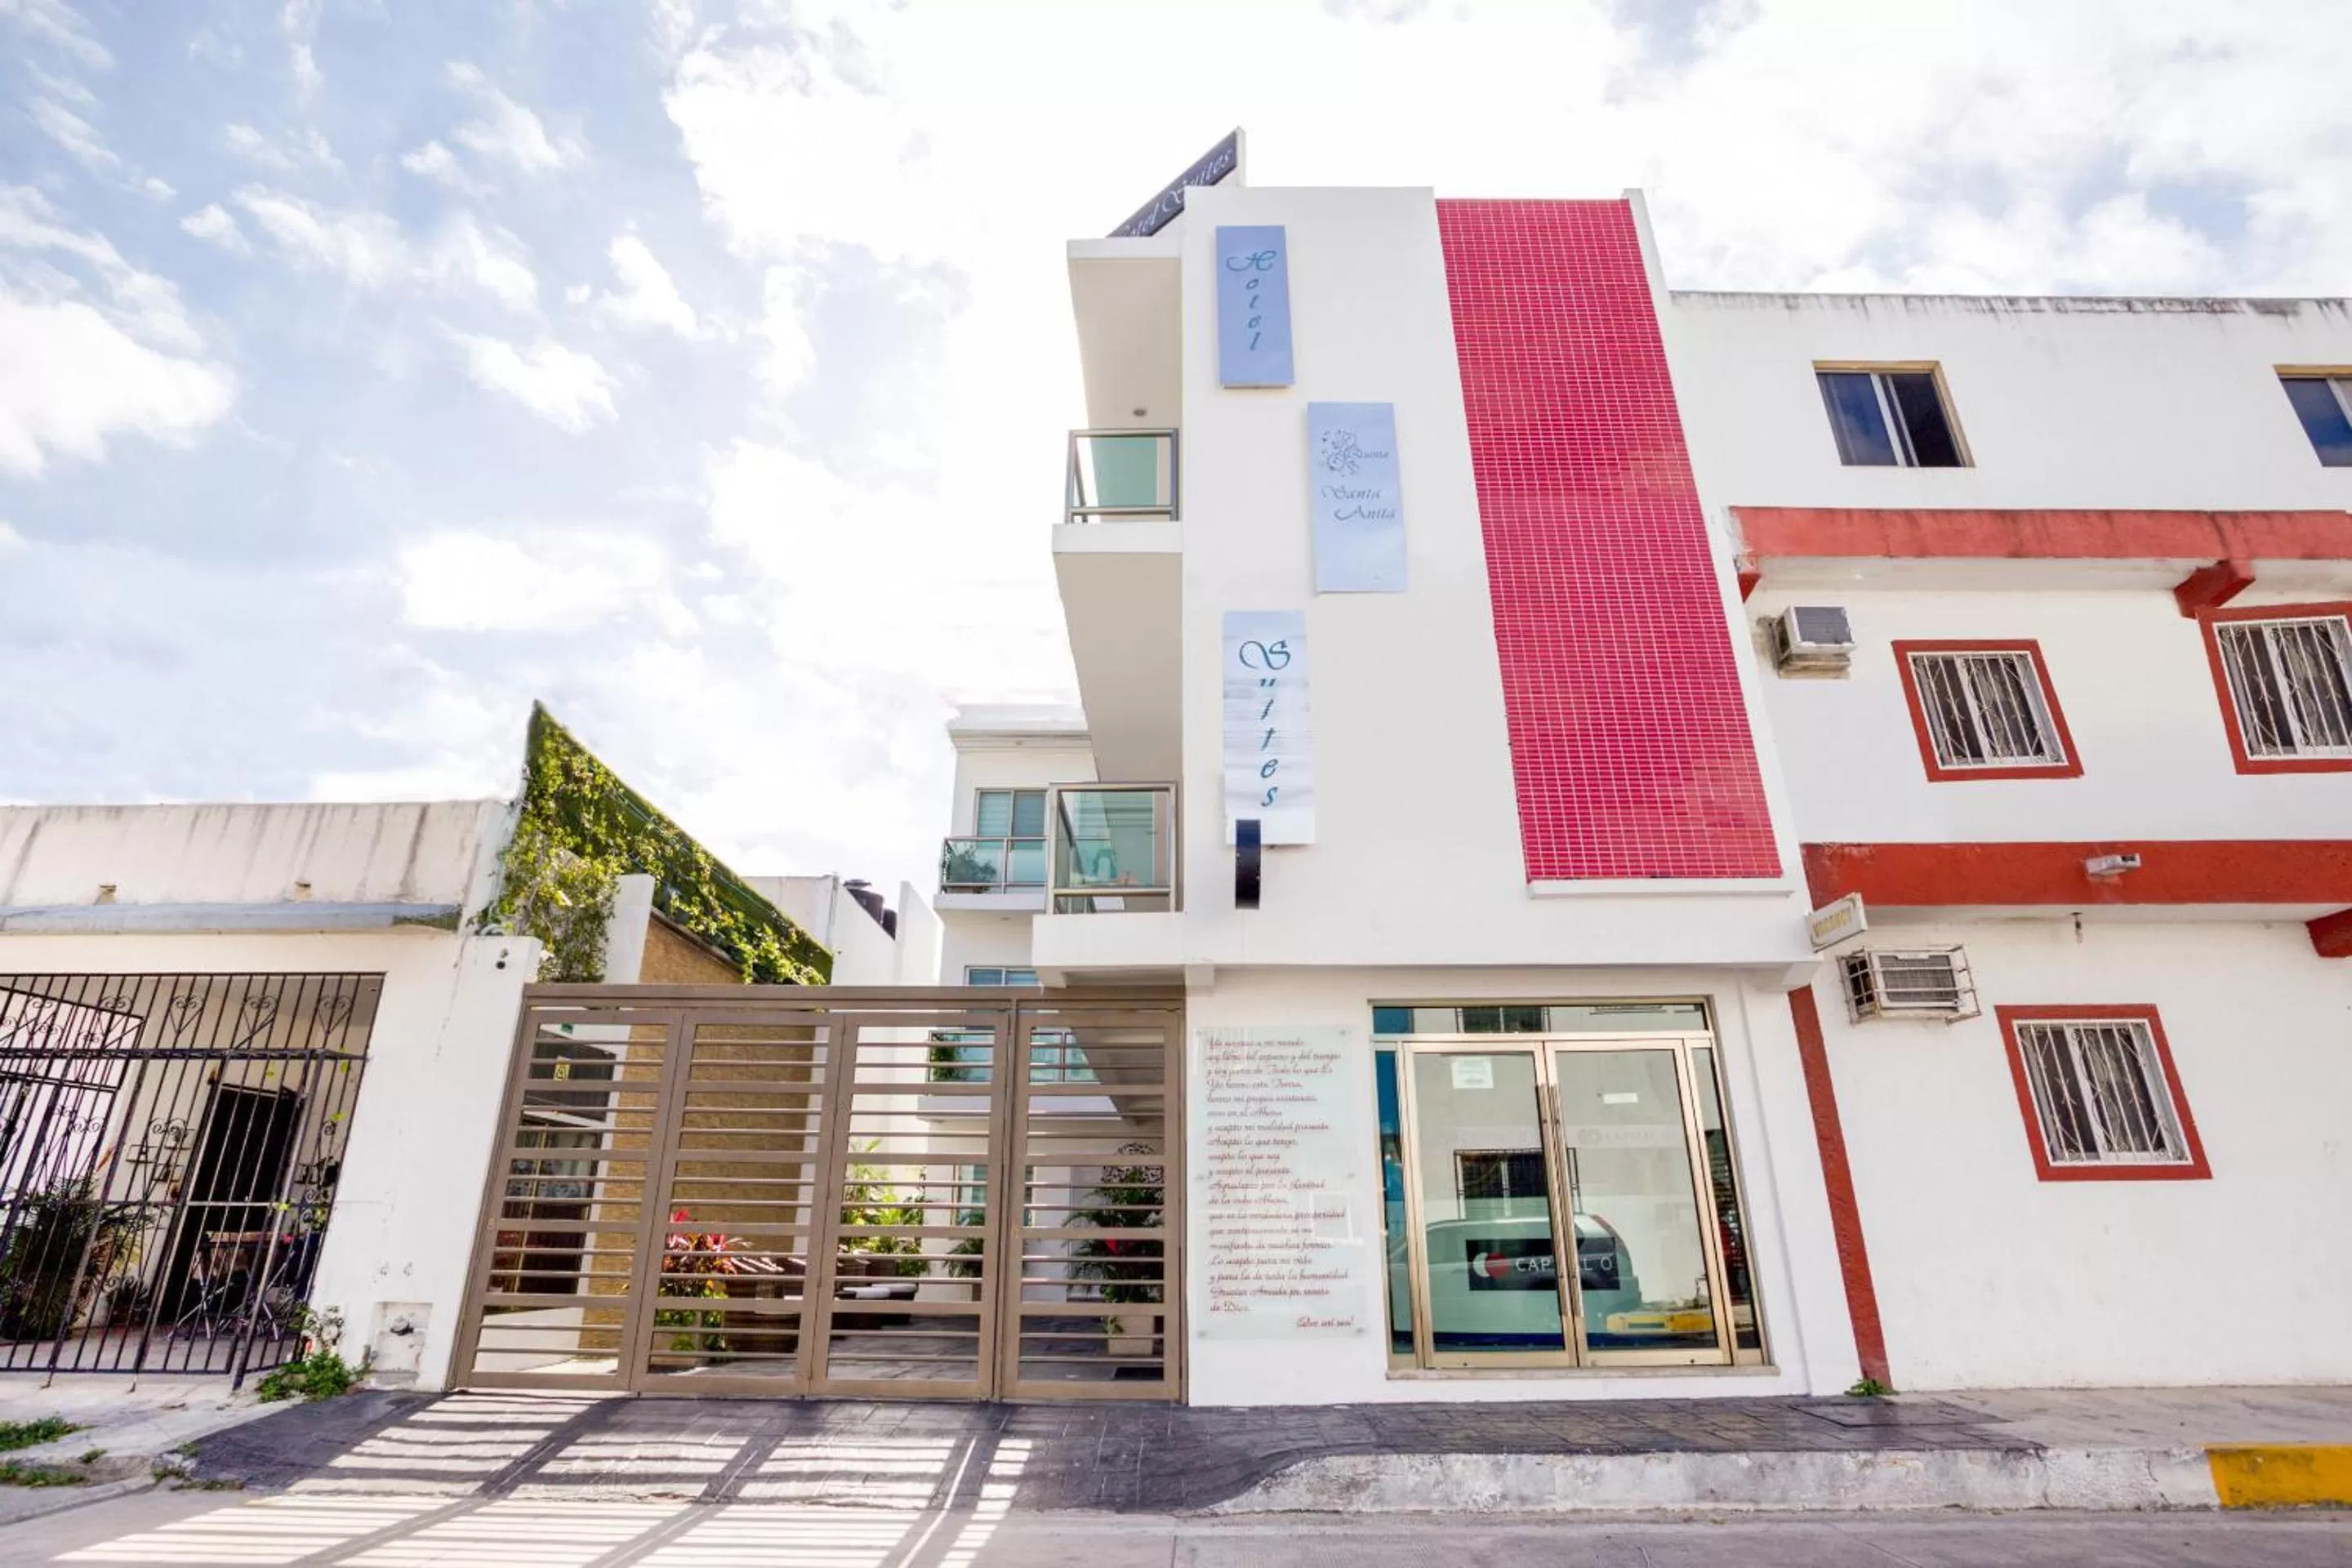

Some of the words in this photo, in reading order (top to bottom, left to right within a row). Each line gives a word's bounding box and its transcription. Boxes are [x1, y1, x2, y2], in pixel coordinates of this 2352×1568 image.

[1321, 484, 1382, 501] Santa
[1334, 505, 1396, 521] Anita
[1240, 639, 1290, 807] Suites
[1516, 1257, 1593, 1272] CAPL
[1601, 1257, 1613, 1272] O
